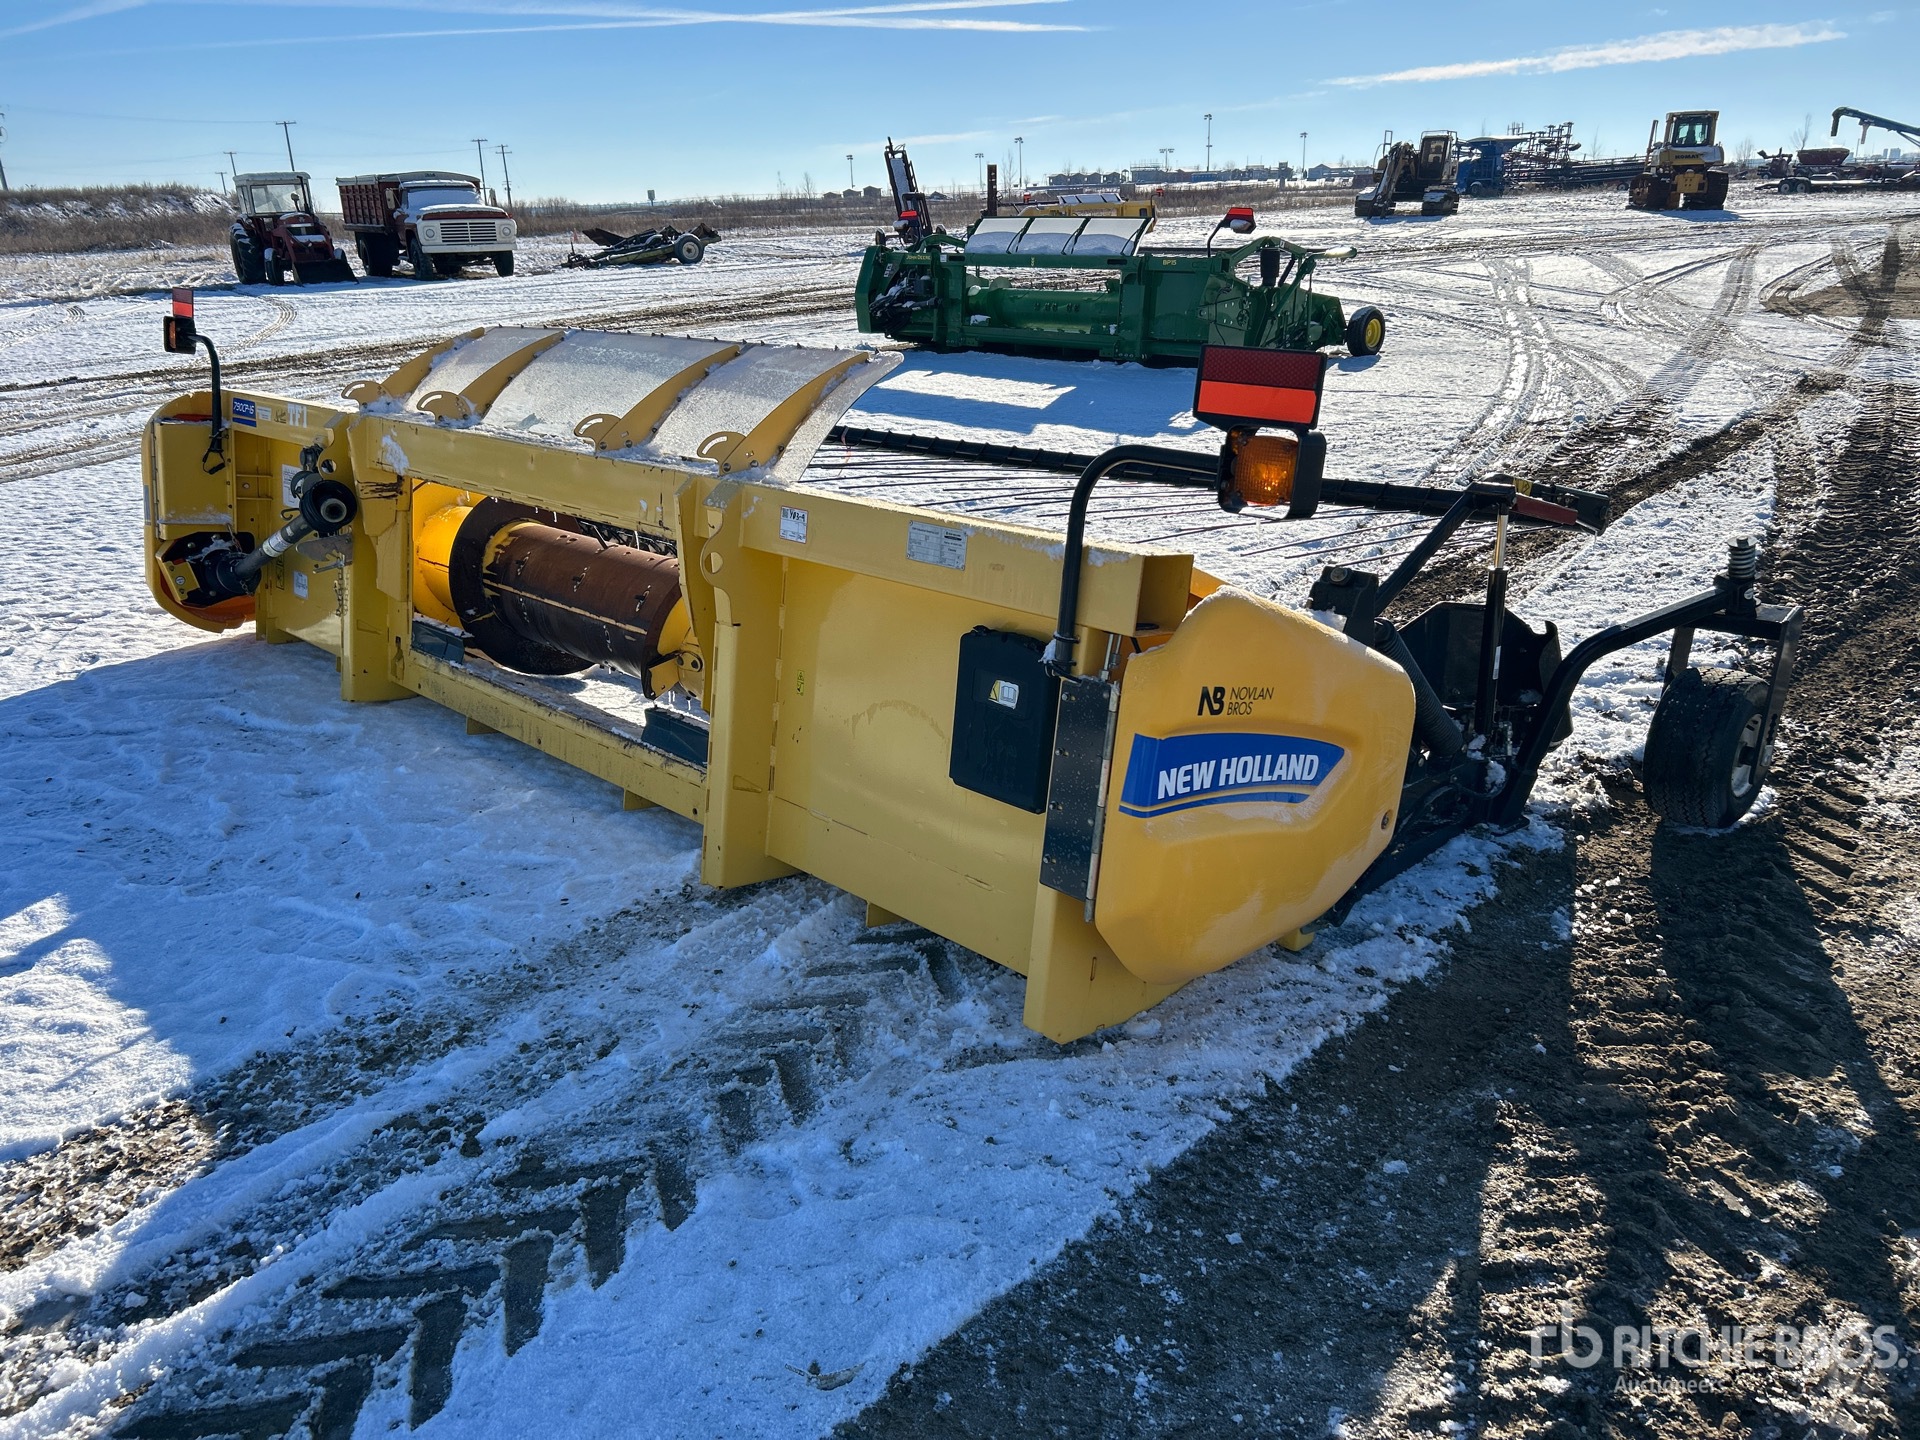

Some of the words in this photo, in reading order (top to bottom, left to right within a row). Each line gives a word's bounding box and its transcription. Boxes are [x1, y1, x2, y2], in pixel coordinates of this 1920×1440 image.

[1197, 686, 1226, 716] NB
[1230, 686, 1274, 700] NOVLAN
[1227, 702, 1253, 715] BROS
[1158, 760, 1216, 800] NEW
[1219, 754, 1319, 787] HOLLAND
